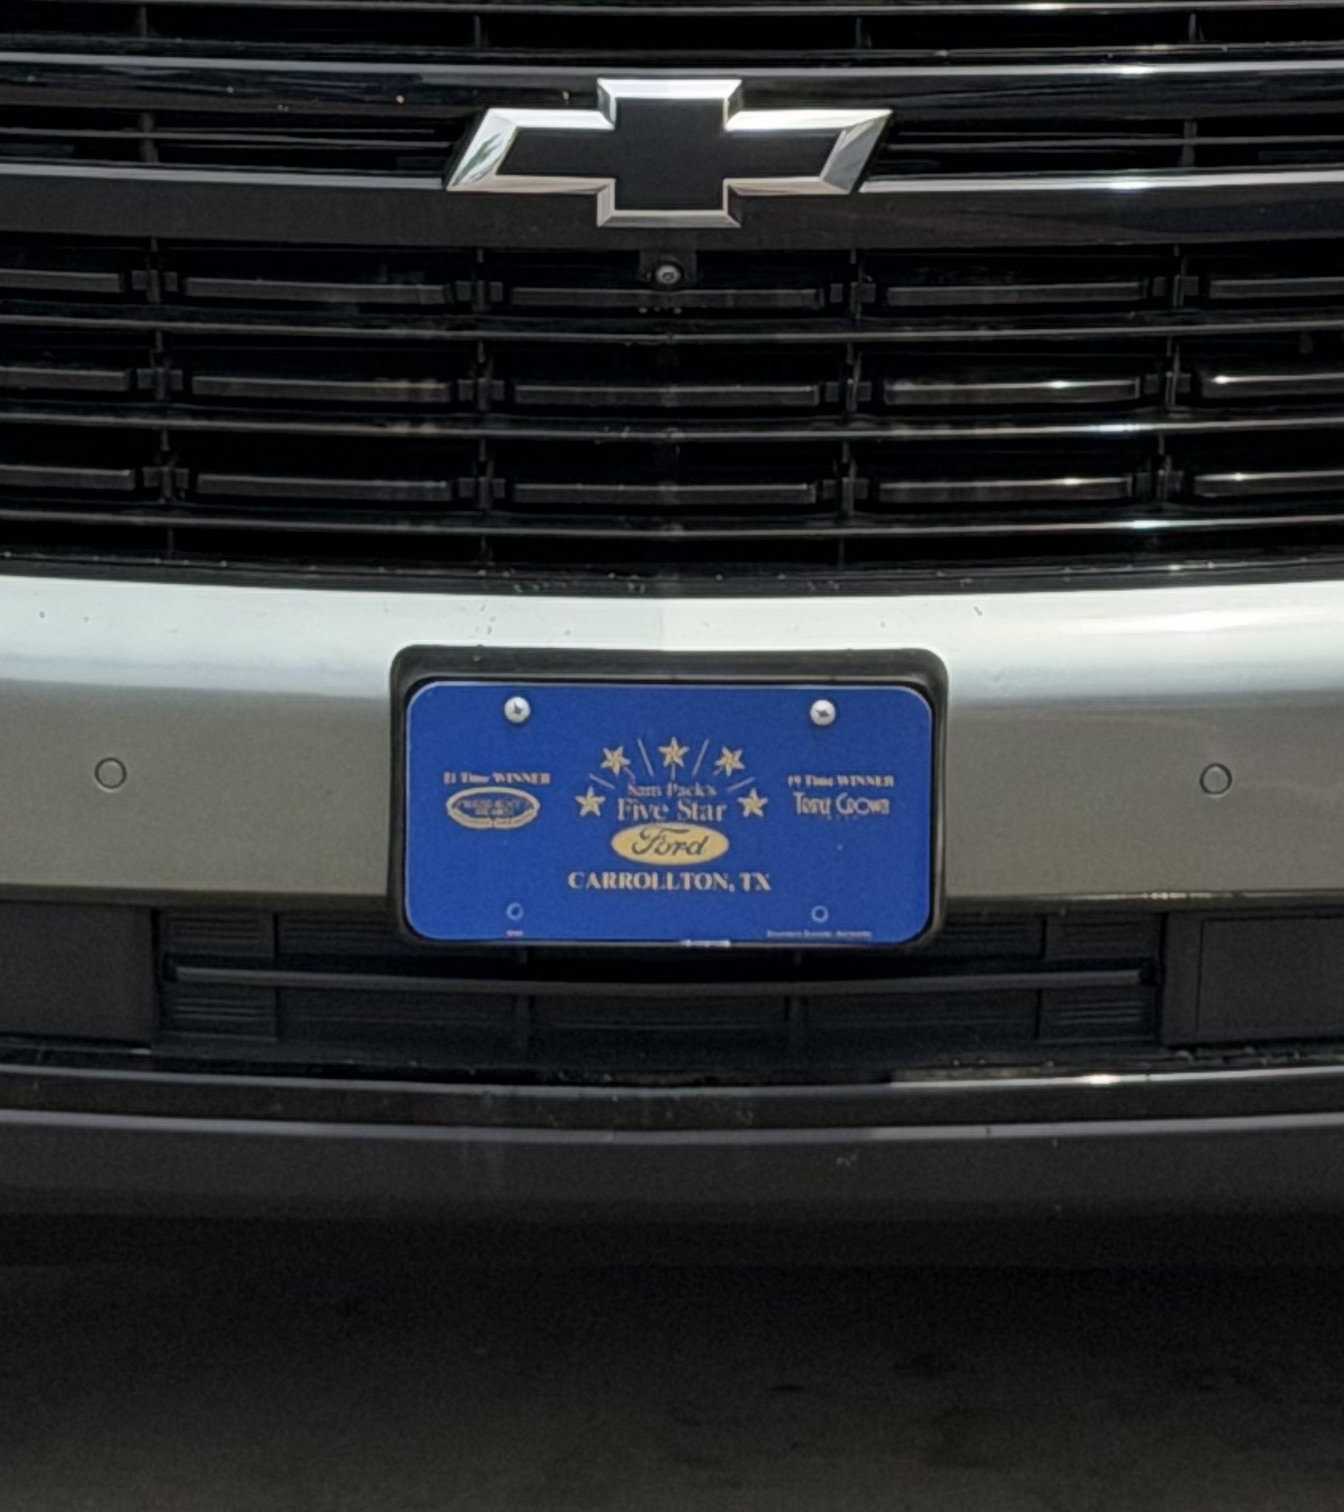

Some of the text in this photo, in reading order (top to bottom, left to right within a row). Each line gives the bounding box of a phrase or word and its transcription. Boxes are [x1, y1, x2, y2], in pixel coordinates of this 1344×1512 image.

[617, 797, 729, 823] Five Star
[631, 825, 710, 857] Ford
[739, 871, 773, 893] TX
